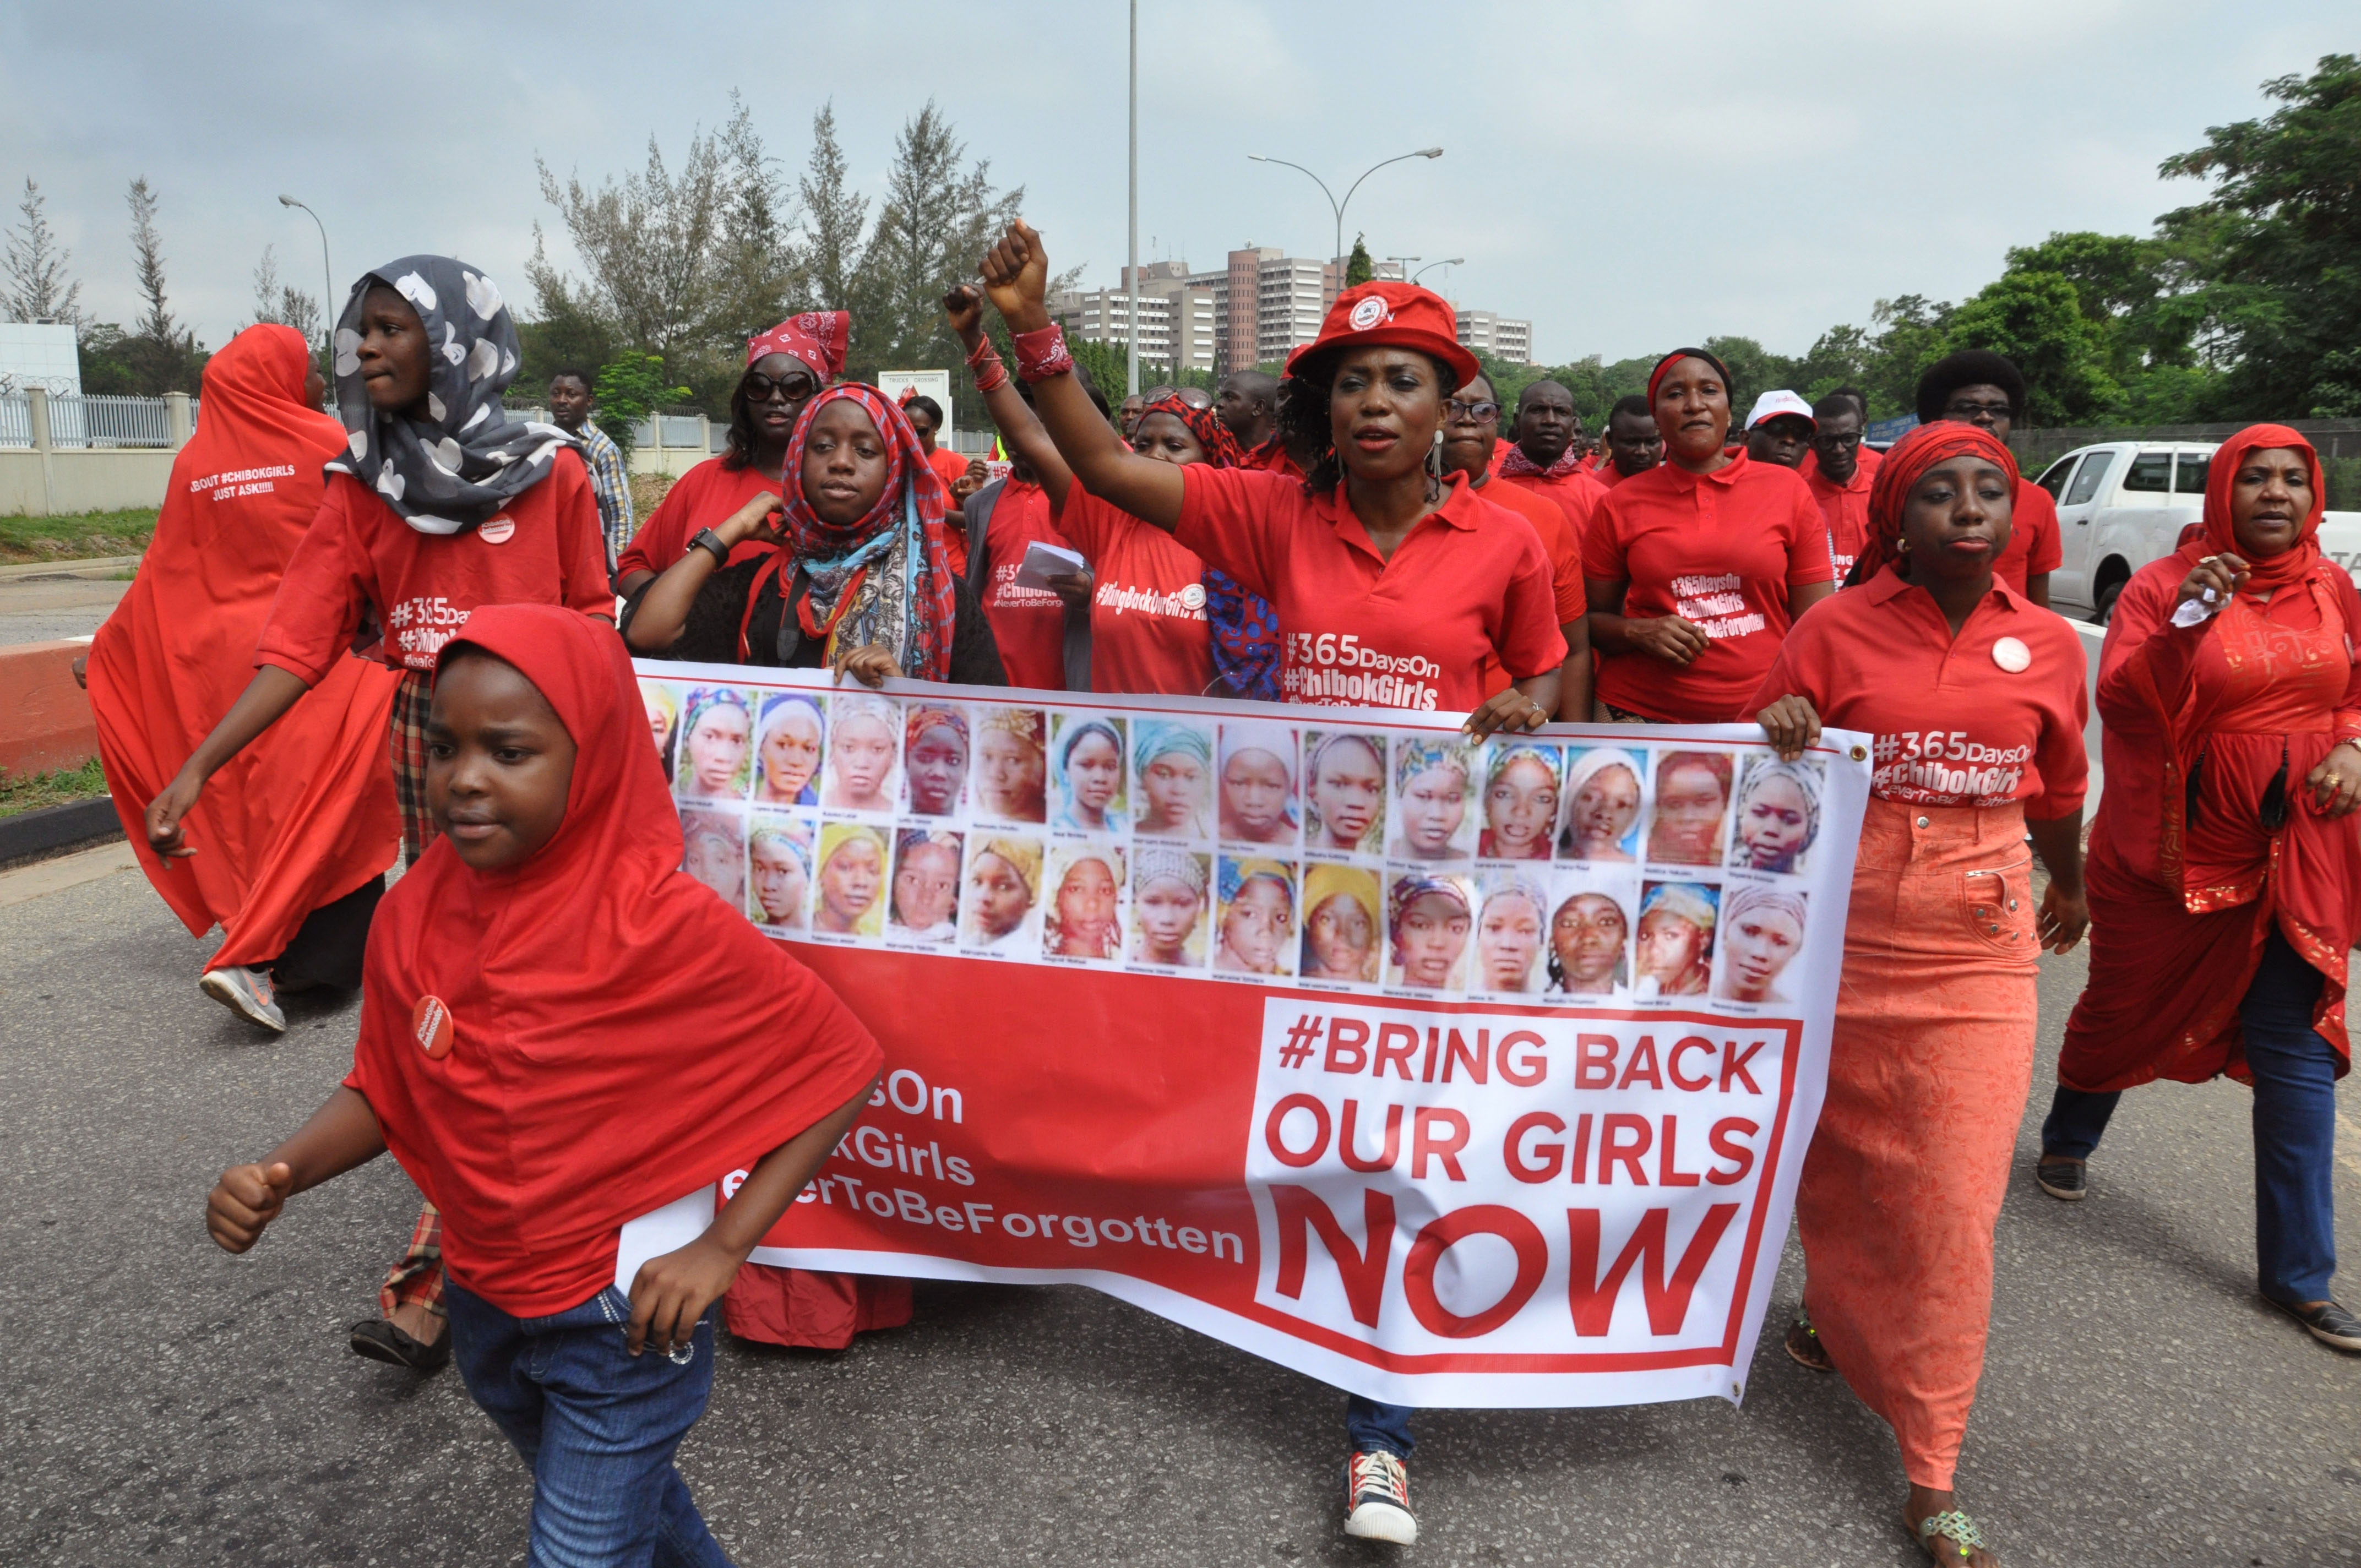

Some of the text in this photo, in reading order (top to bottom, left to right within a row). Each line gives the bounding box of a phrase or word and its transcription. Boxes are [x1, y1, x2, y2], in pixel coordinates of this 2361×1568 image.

[213, 486, 236, 501] JUST
[221, 465, 295, 484] #CHIBOKGIRLS
[1671, 573, 1741, 597] #365DaysOn
[1677, 592, 1745, 619] #ChibokGirls
[1287, 633, 1440, 678] #365DaysOn
[1284, 666, 1438, 711] #ChibokGirls
[1279, 1014, 1766, 1095] #BRING BACK
[831, 1125, 975, 1185] kGirls
[1265, 1093, 1760, 1186] OUR GIRLS
[1267, 1184, 1741, 1339] NOW
